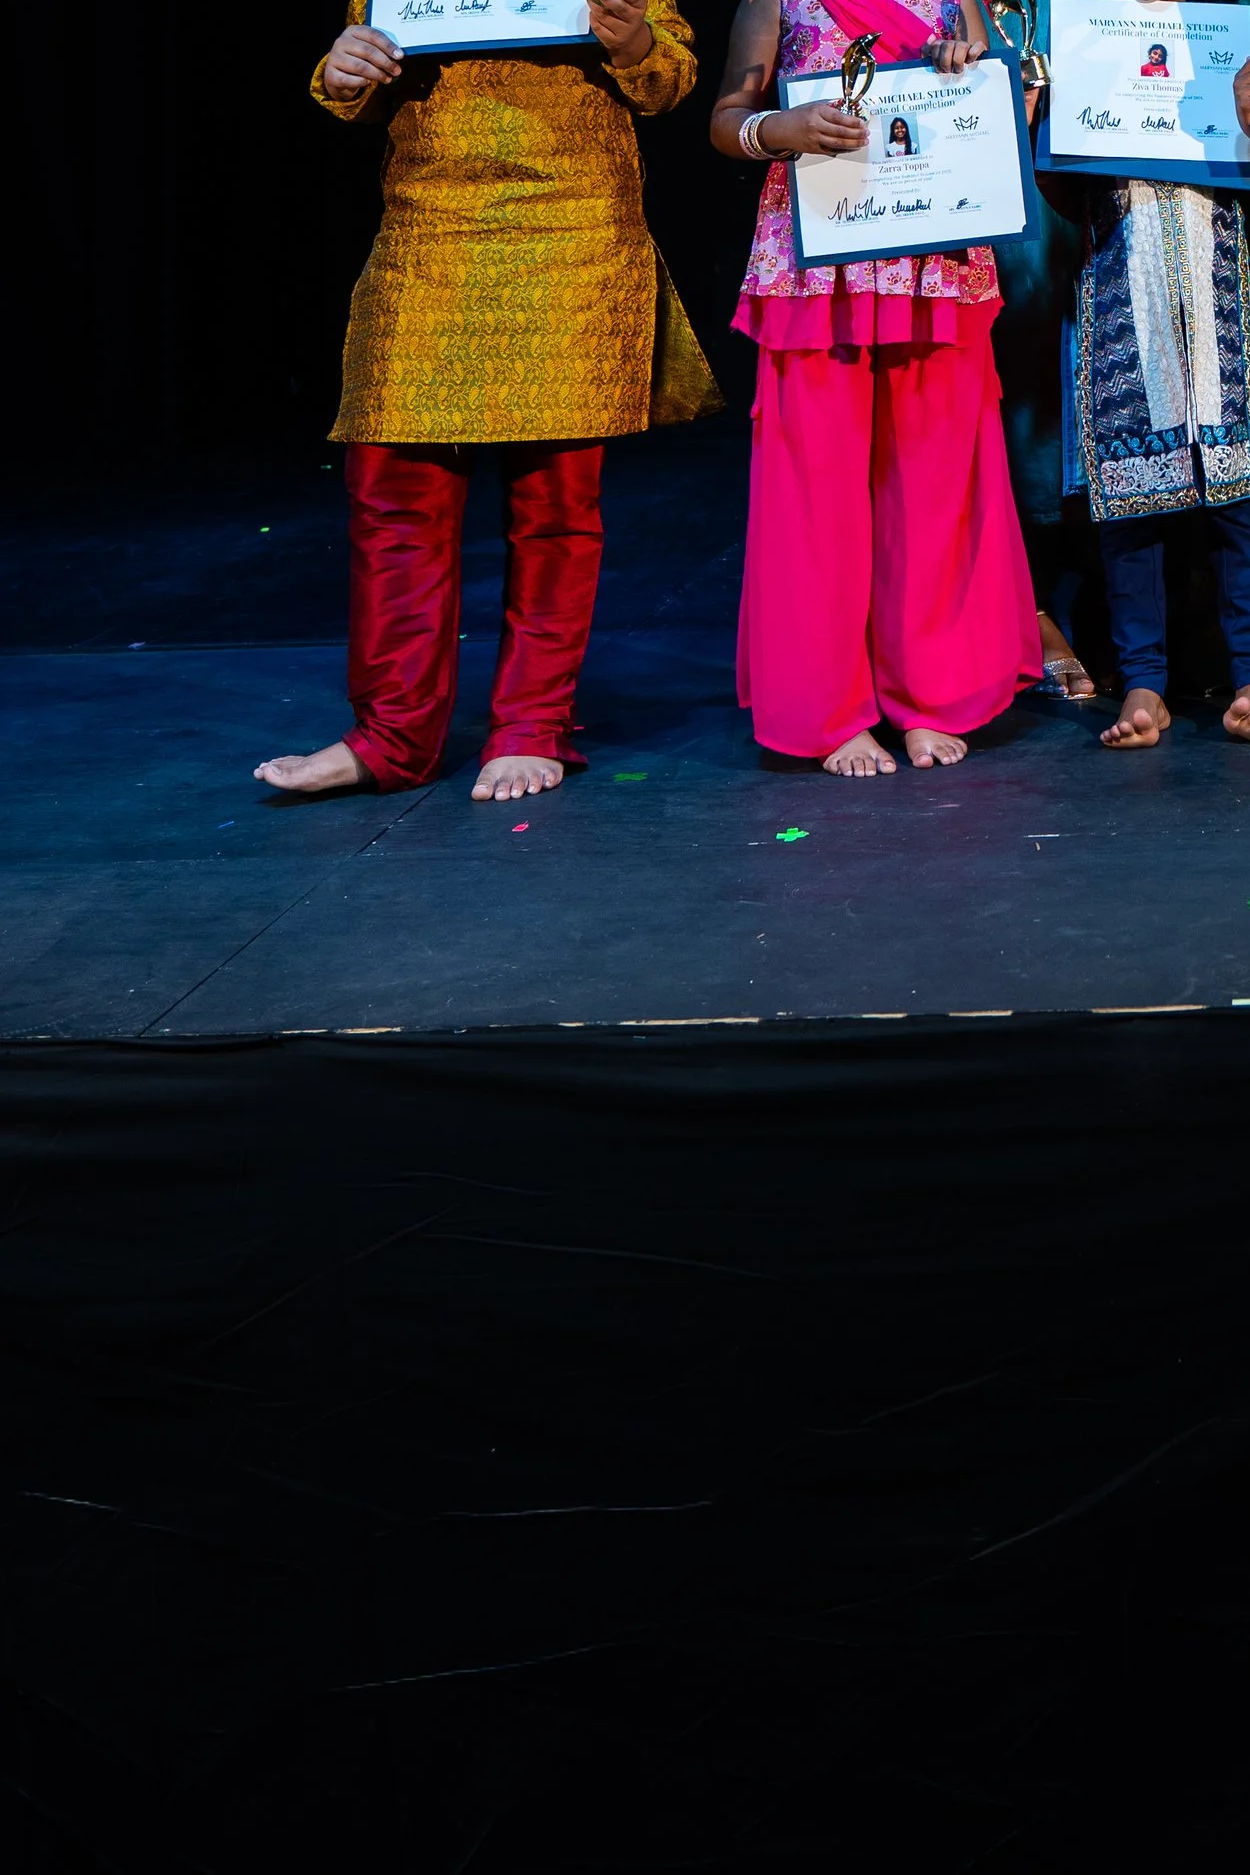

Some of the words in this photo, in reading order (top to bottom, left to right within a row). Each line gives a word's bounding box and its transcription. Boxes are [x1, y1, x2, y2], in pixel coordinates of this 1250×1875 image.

[1089, 19, 1136, 27] MARYANN
[1140, 21, 1184, 30] MICHAEL
[1187, 24, 1228, 32] STUDIOS
[1102, 28, 1148, 37] Certificate
[1162, 31, 1212, 41] Completion
[1133, 83, 1149, 91] Ziva
[879, 92, 925, 104] MICHAEL
[928, 87, 971, 99] STUDIOS
[891, 106, 900, 114] of
[902, 100, 955, 111] Completion
[903, 162, 929, 171] Toppa
